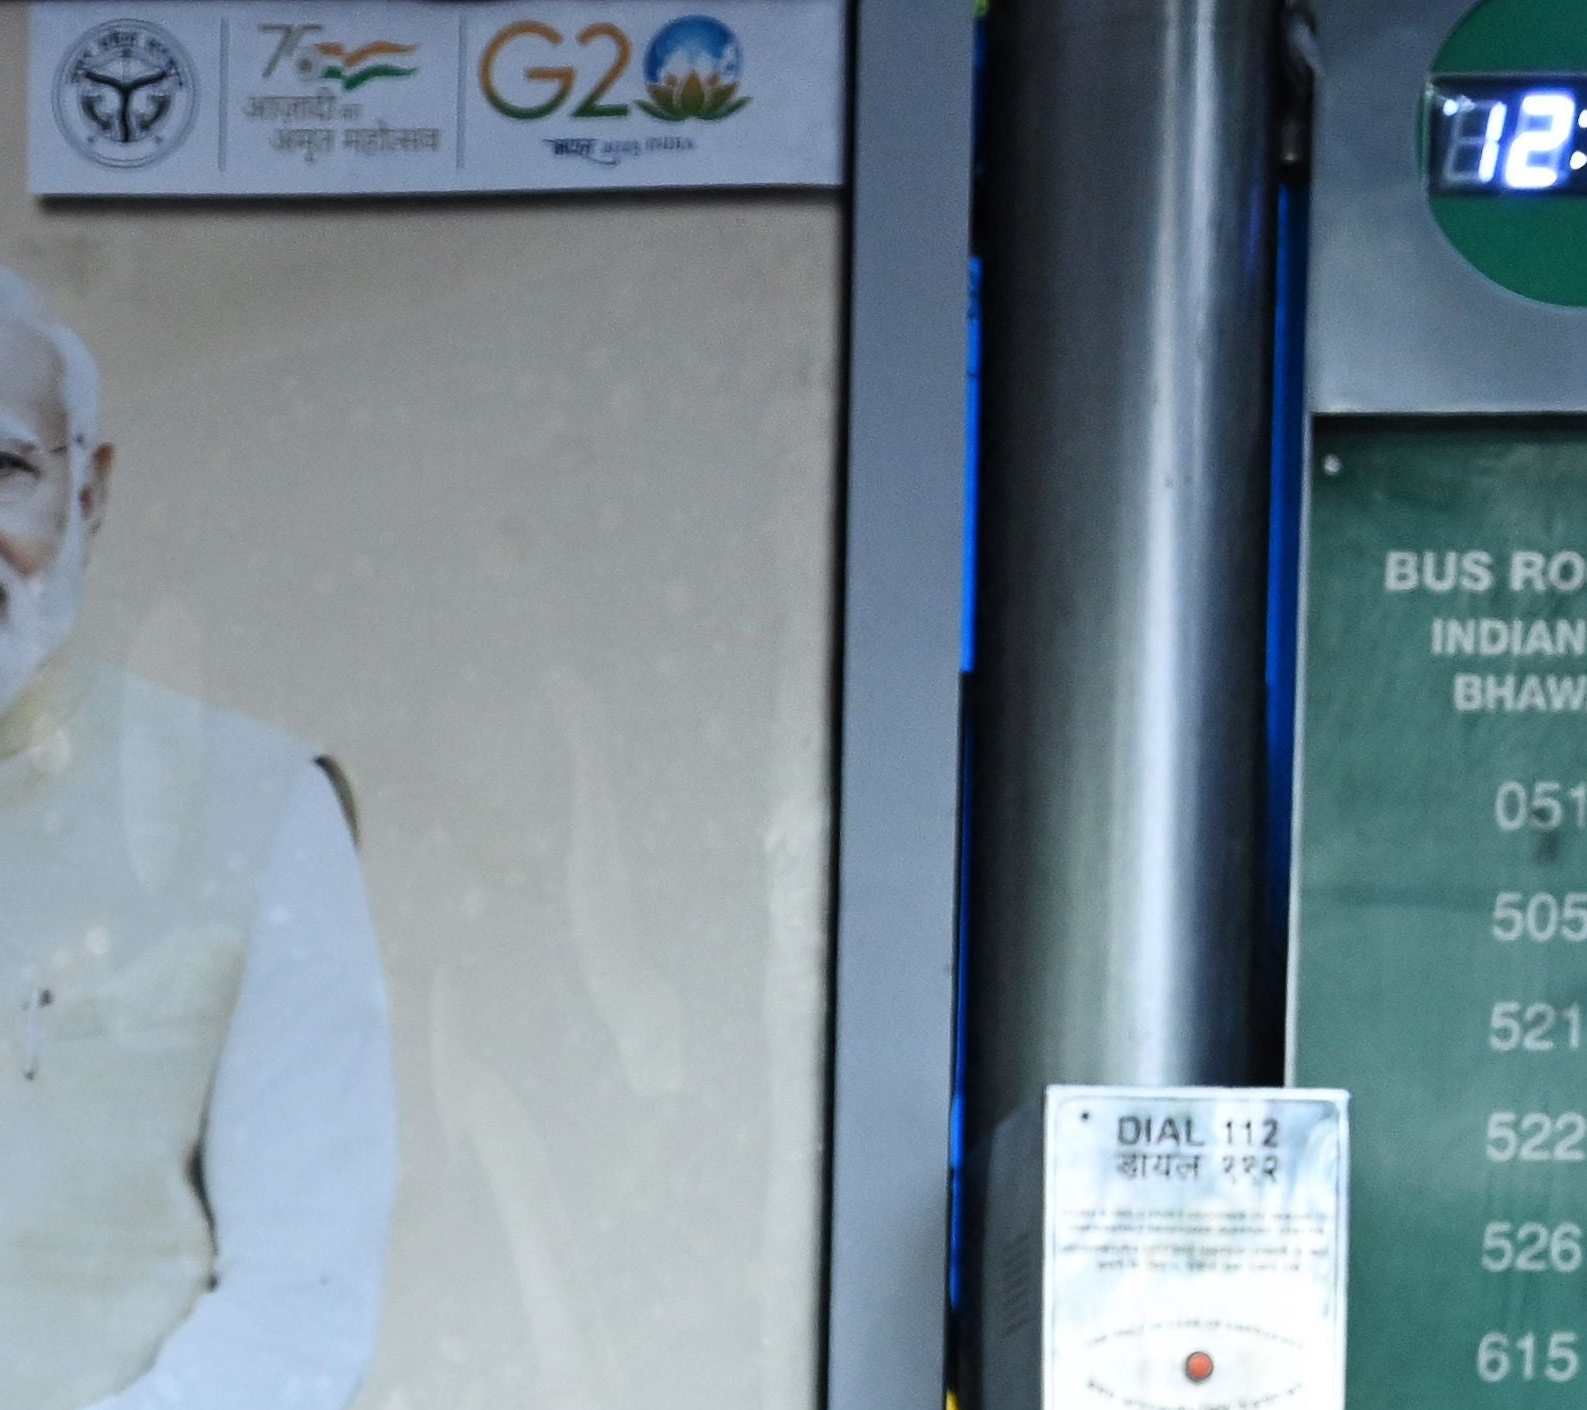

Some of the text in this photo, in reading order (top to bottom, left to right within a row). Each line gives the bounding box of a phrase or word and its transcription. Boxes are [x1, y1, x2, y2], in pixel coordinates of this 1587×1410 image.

[1383, 551, 1492, 593] BUS
[1431, 619, 1587, 656] INDIAN
[1488, 1002, 1582, 1051] 521
[1116, 1115, 1280, 1149] DIAL 112
[1480, 1222, 1584, 1272] 526
[1476, 1332, 1579, 1382] 615
